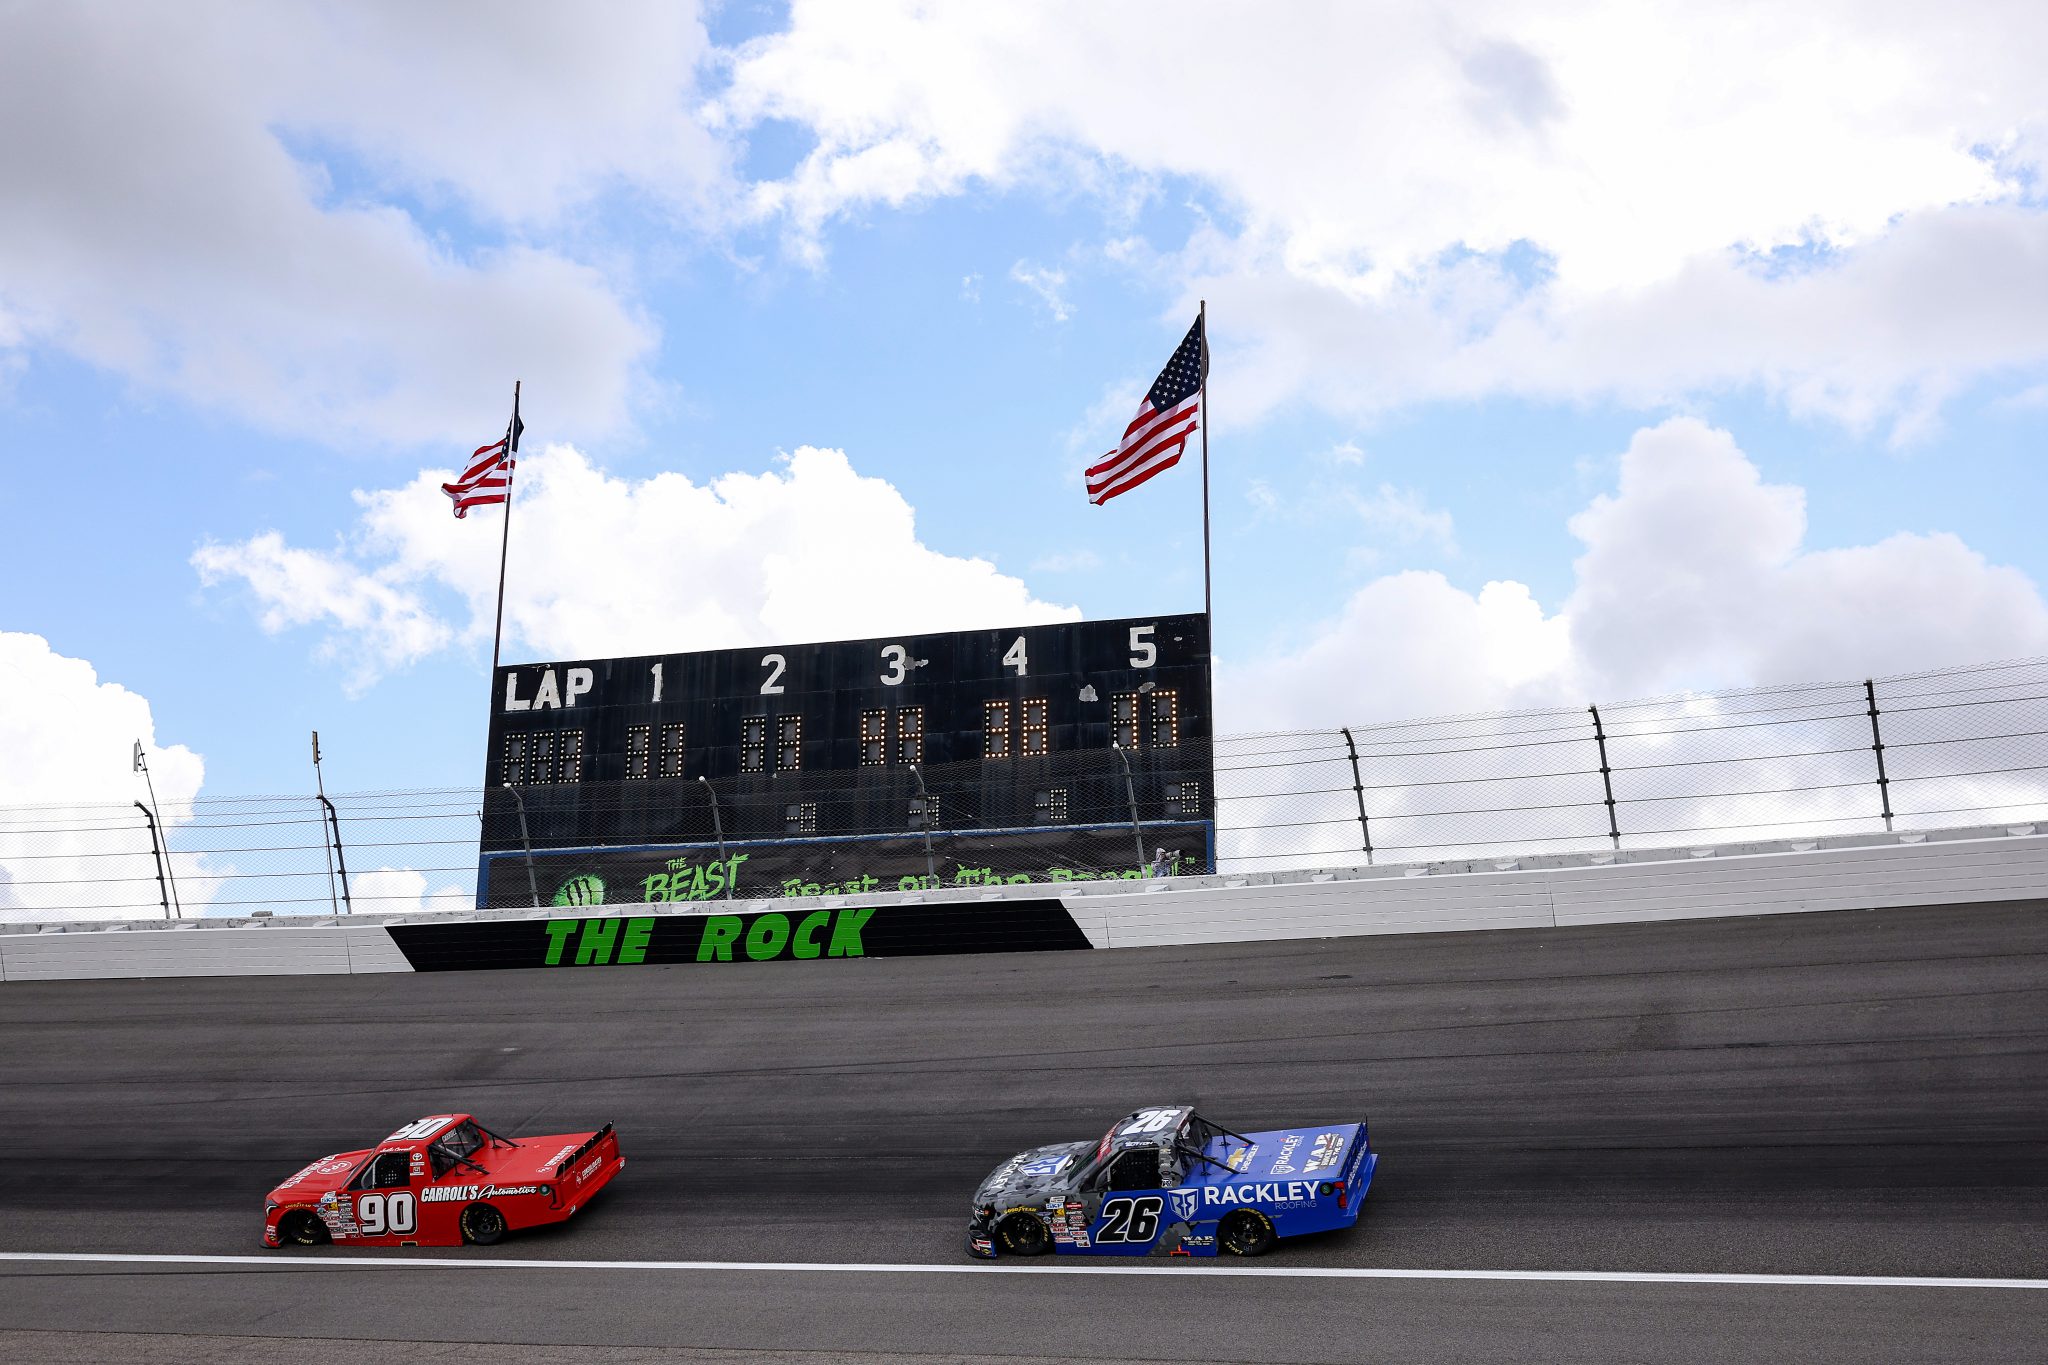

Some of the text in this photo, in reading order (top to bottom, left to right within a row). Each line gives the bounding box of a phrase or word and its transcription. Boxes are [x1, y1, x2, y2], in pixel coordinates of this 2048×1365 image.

[505, 626, 1157, 711] LAP 1 2 3 4 5
[637, 852, 750, 904] BEAST
[665, 857, 687, 871] THE
[545, 908, 876, 965] THE ROCK
[384, 1117, 455, 1143] 90
[1120, 1109, 1182, 1136] 26
[1275, 1134, 1300, 1165] RACKLEY
[421, 1184, 538, 1203] CARROLL'S Automotive
[1204, 1181, 1320, 1206] RACKLEY
[1275, 1200, 1318, 1211] ROOFING
[358, 1192, 418, 1236] 90
[1095, 1197, 1164, 1244] 26
